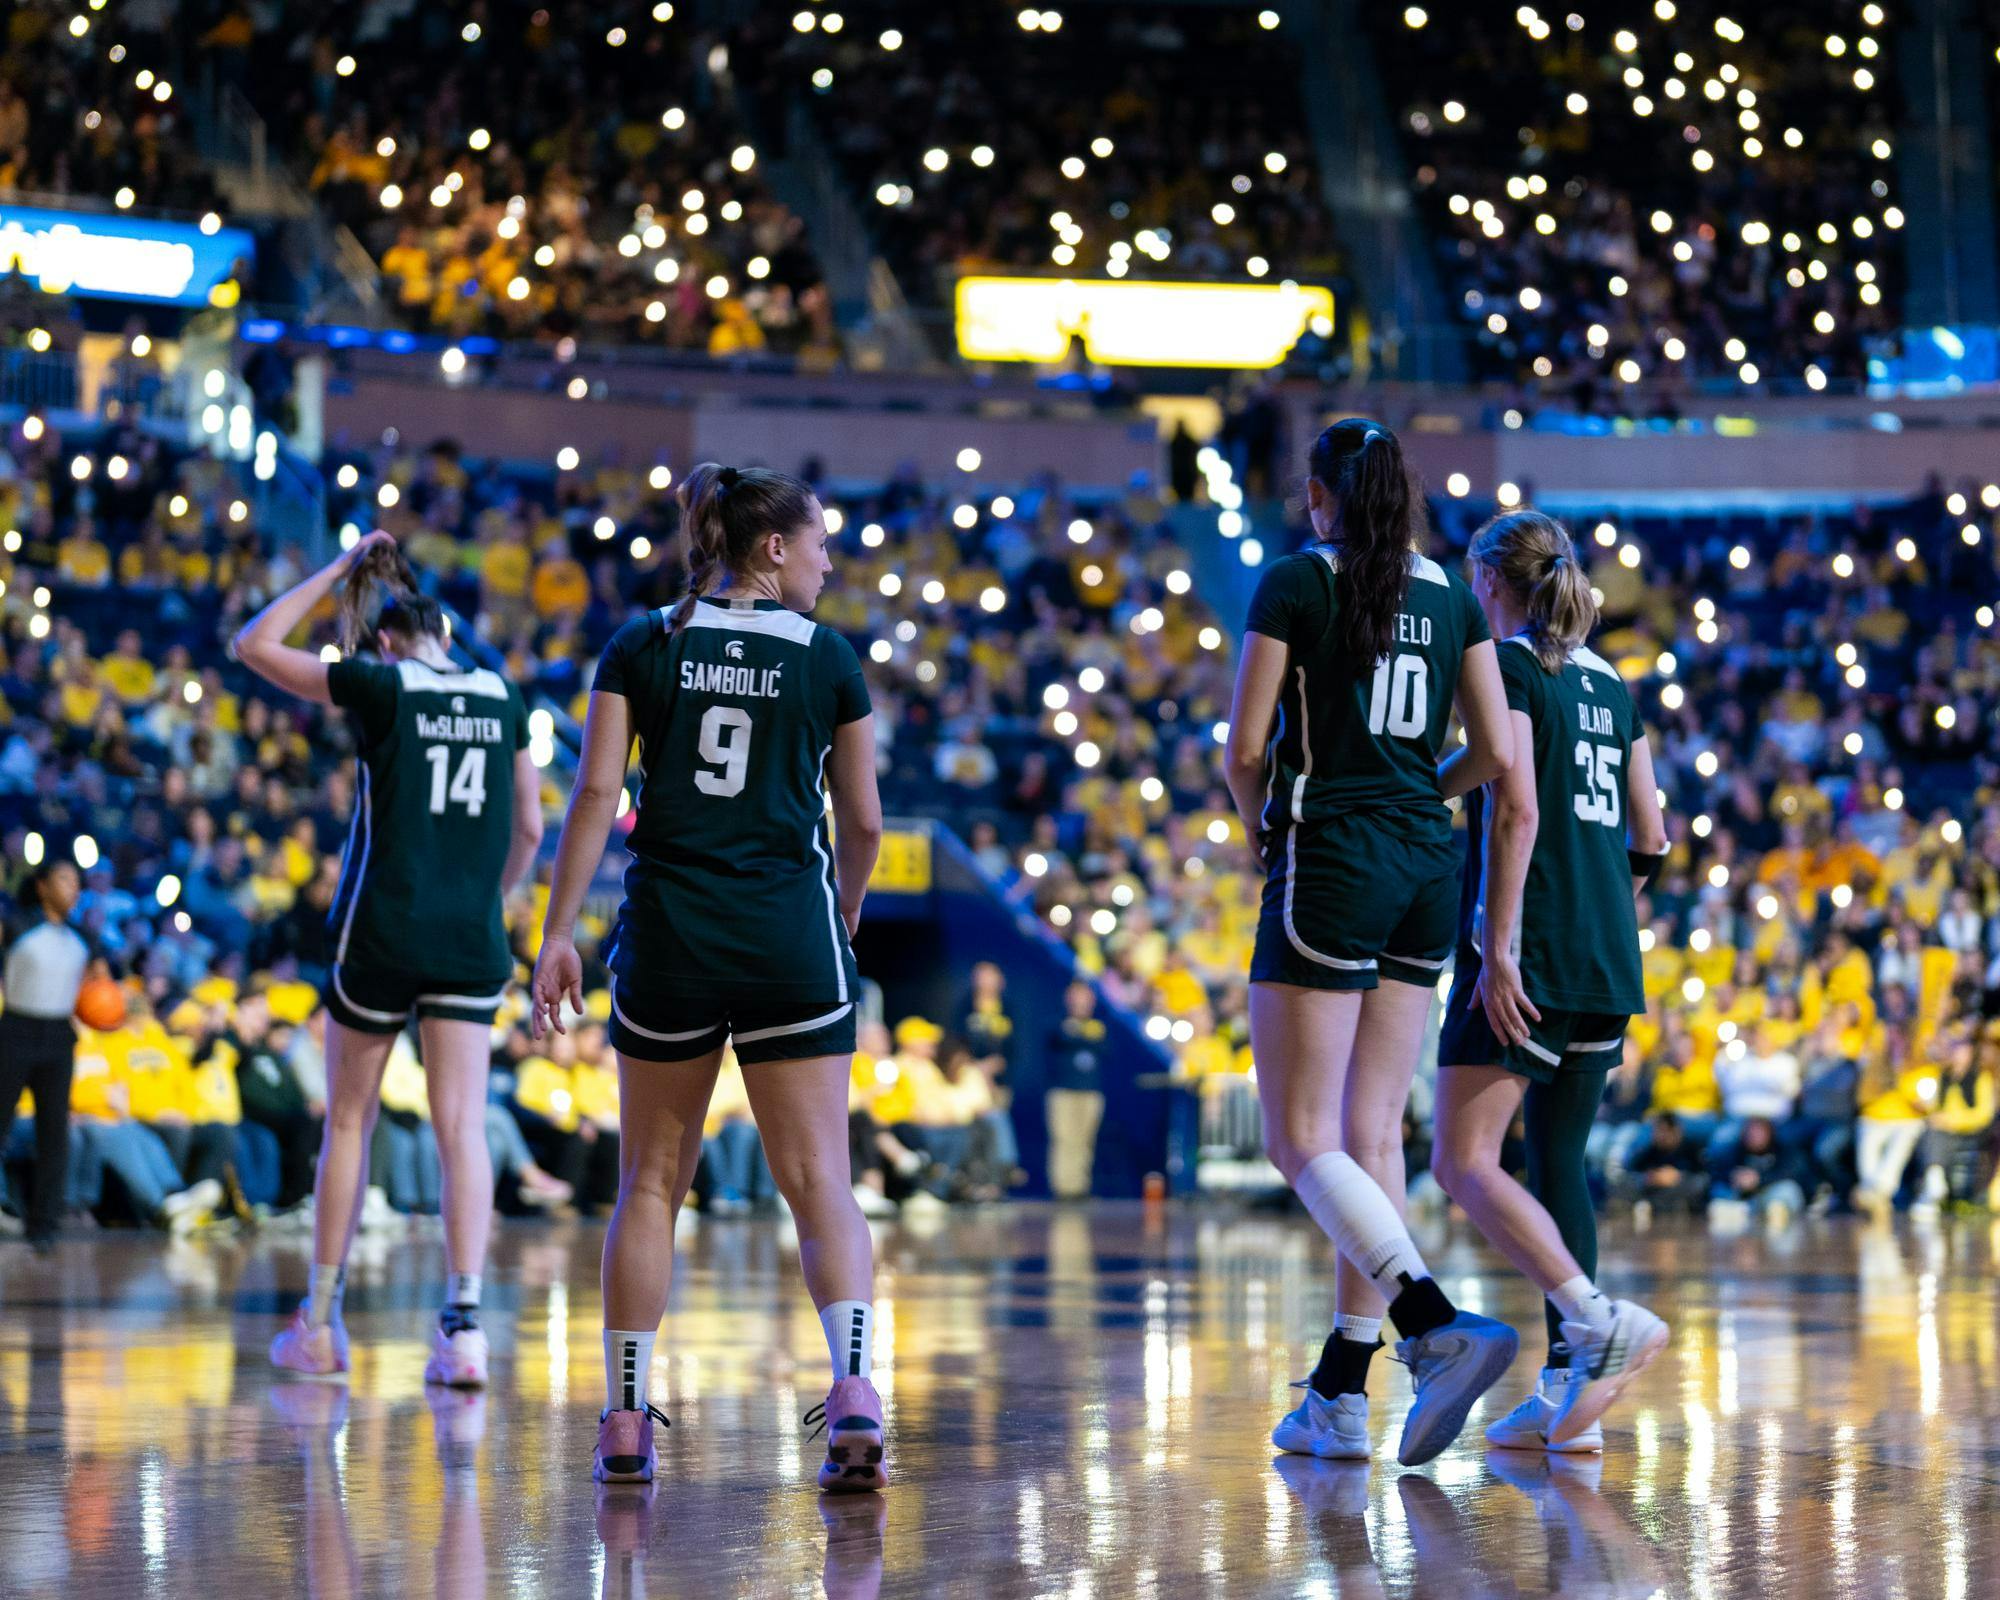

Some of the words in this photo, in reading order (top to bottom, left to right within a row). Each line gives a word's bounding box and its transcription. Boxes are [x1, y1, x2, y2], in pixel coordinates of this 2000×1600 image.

[680, 660, 784, 698] SAMBOLIĆ
[1368, 651, 1428, 739] 10
[1577, 702, 1613, 736] BLAIR
[425, 744, 487, 816] 14
[694, 705, 753, 798] 9
[1573, 739, 1623, 828] 35
